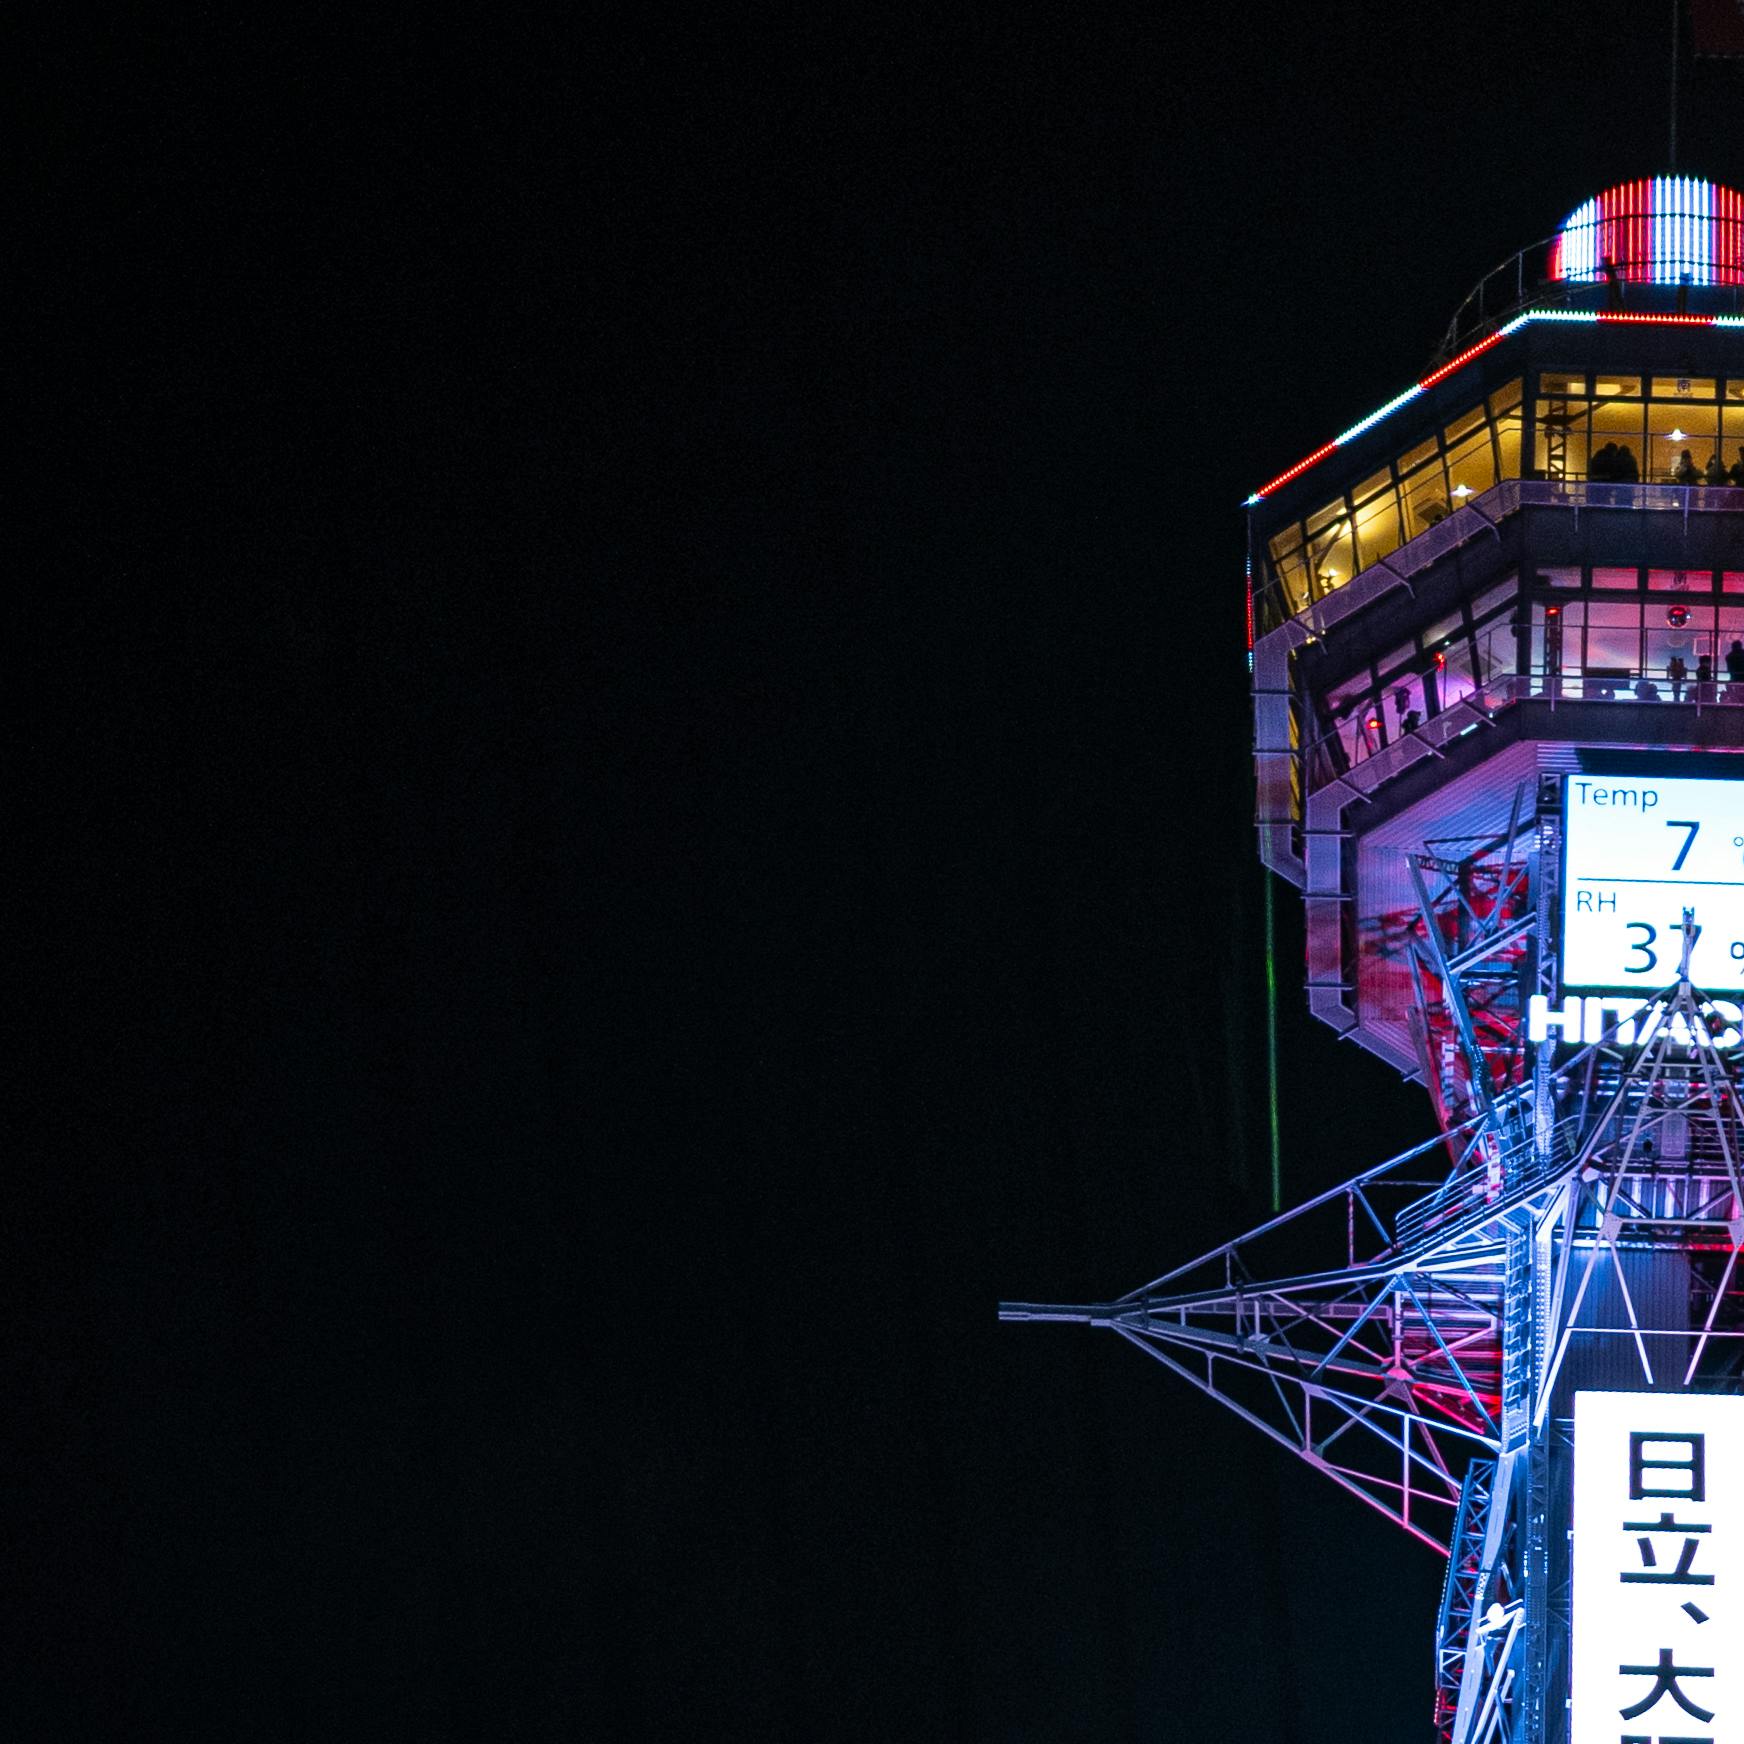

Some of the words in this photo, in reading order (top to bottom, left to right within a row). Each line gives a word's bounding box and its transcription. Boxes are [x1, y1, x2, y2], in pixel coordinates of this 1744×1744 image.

[1575, 782, 1658, 812] Temp
[1666, 820, 1700, 872] 7
[1577, 890, 1616, 913] RH
[1624, 921, 1703, 974] 37
